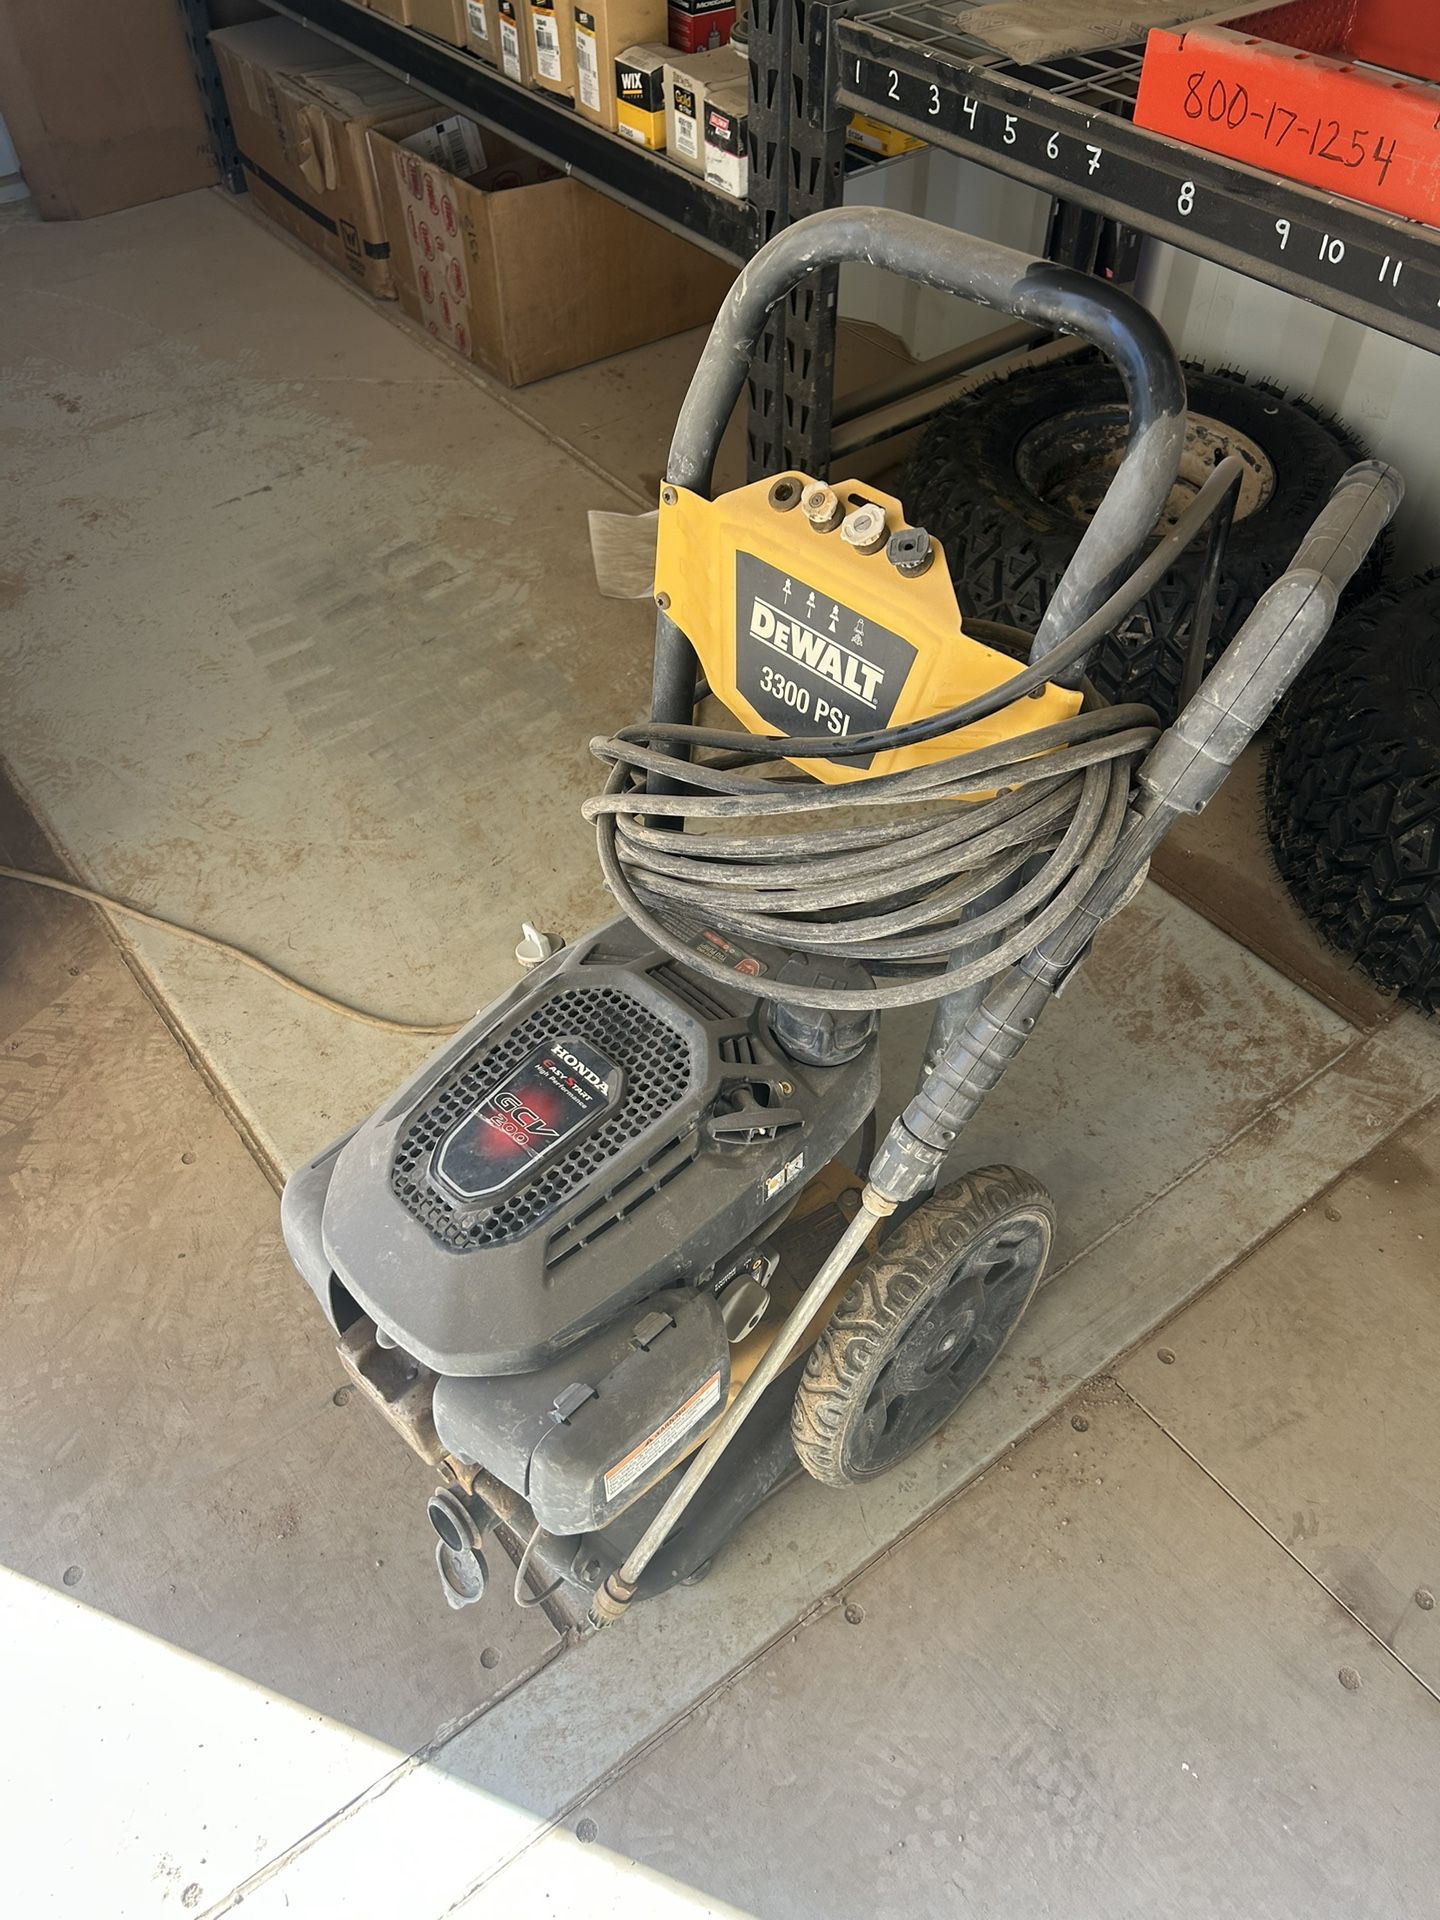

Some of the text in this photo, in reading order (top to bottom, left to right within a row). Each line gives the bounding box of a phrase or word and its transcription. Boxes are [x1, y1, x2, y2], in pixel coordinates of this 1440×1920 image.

[621, 72, 643, 89] WIX
[675, 89, 692, 108] Gold
[1183, 70, 1397, 187] 800-17-1254
[855, 60, 1402, 287] 1 2 3 4 5 6 7 8 9 10 11
[760, 666, 851, 737] 3300 PSI
[534, 1064, 588, 1109] High Performance
[550, 1043, 609, 1097] HONDA
[490, 1113, 529, 1145] 200
[494, 1091, 560, 1137] GCV
